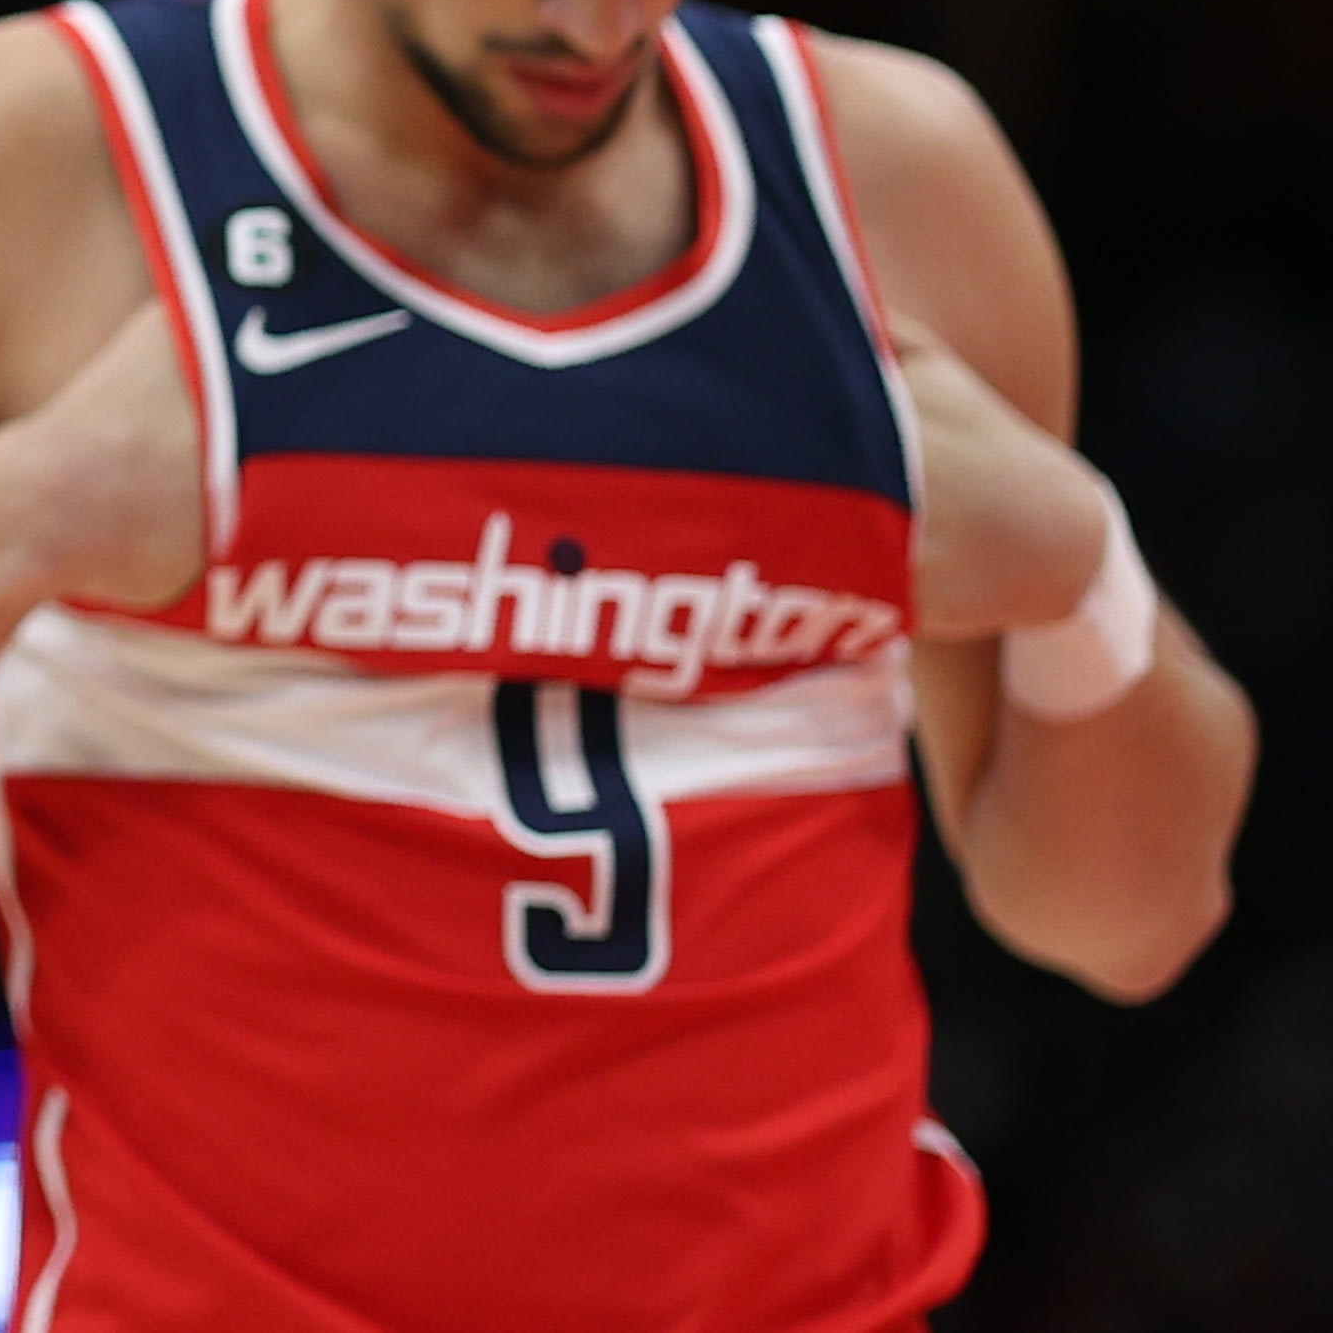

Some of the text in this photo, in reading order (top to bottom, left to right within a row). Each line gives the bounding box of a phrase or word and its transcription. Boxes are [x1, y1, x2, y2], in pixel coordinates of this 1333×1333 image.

[226, 206, 294, 286] 6
[206, 511, 901, 700] washington
[491, 679, 671, 995] 9
